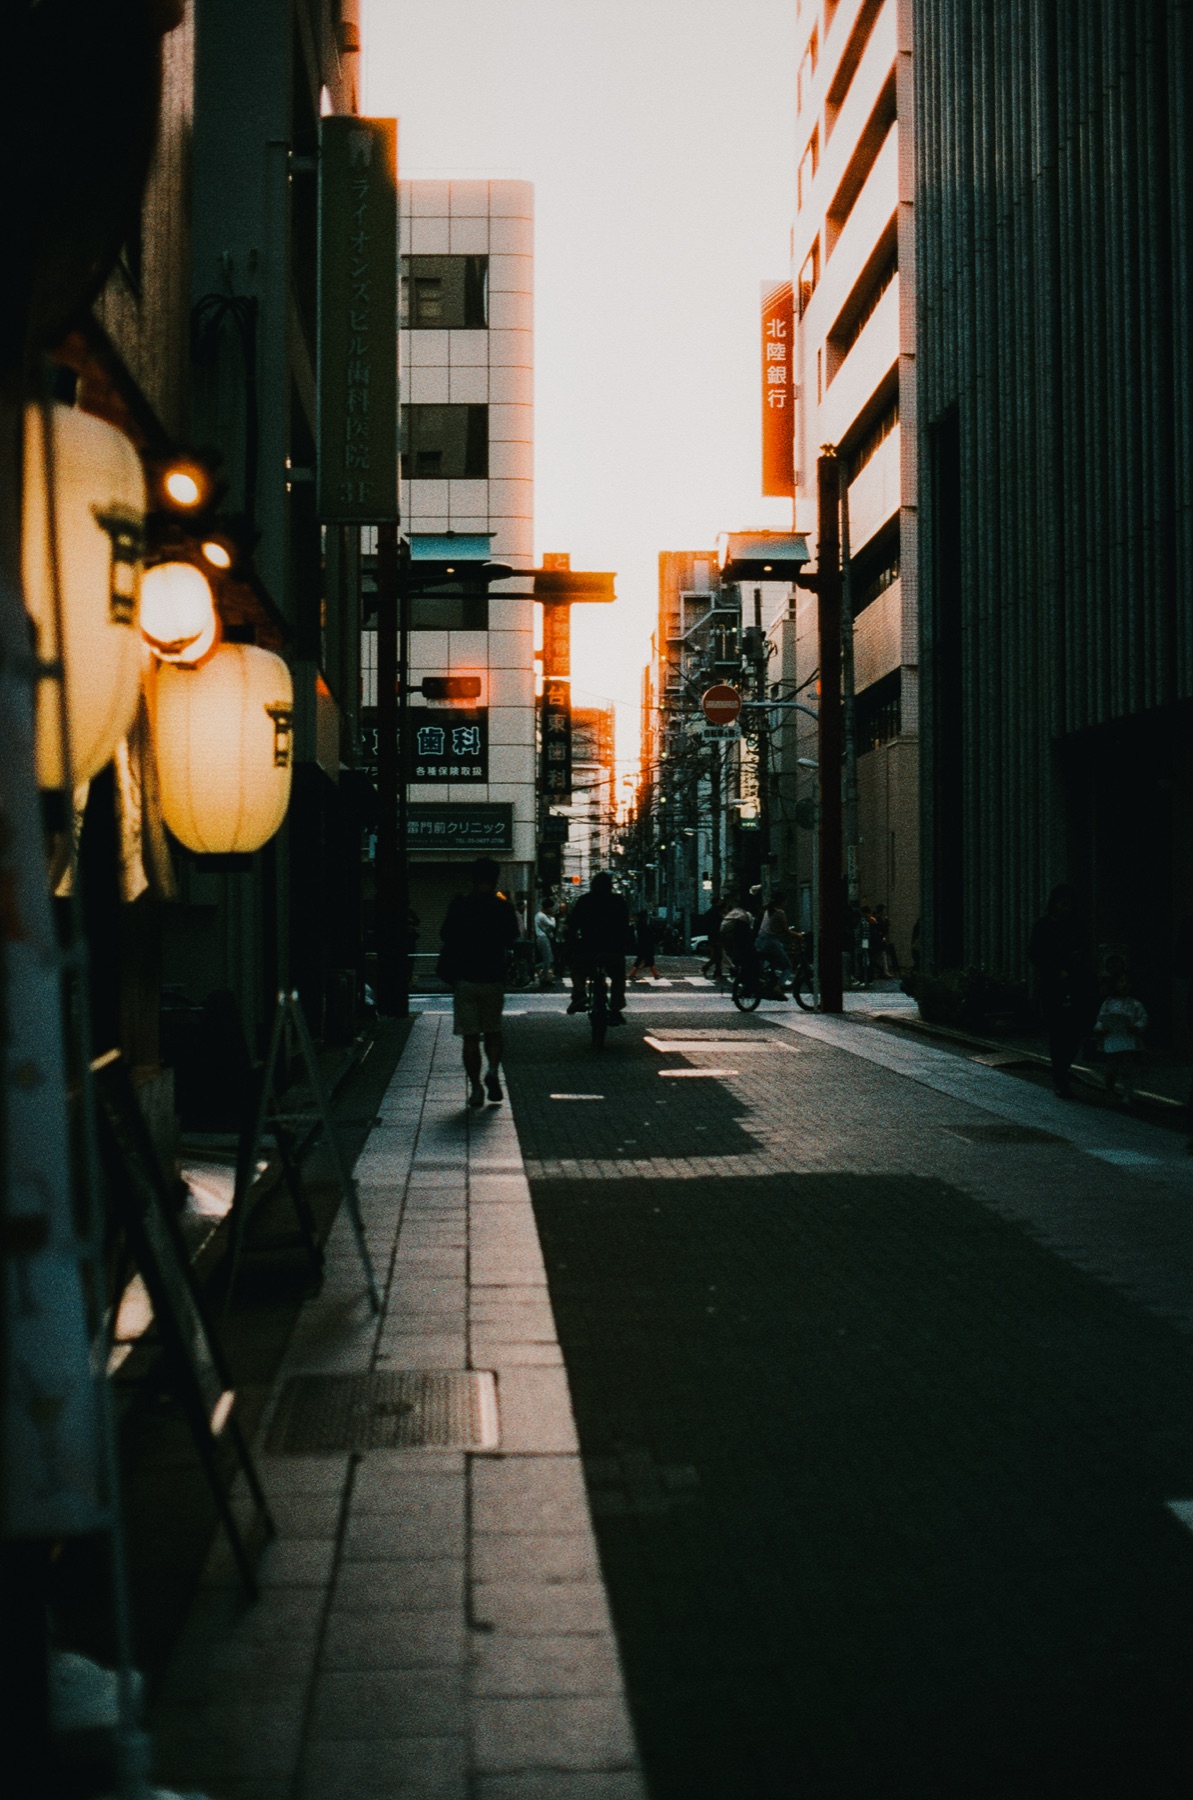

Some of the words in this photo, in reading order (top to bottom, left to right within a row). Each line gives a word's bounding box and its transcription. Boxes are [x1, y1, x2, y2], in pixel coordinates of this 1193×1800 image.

[766, 318, 787, 409] 北陸銀行
[546, 685, 568, 789] 台東歯科
[415, 766, 482, 777] 各種保険取扱
[406, 821, 506, 835] 雷門前クリニック
